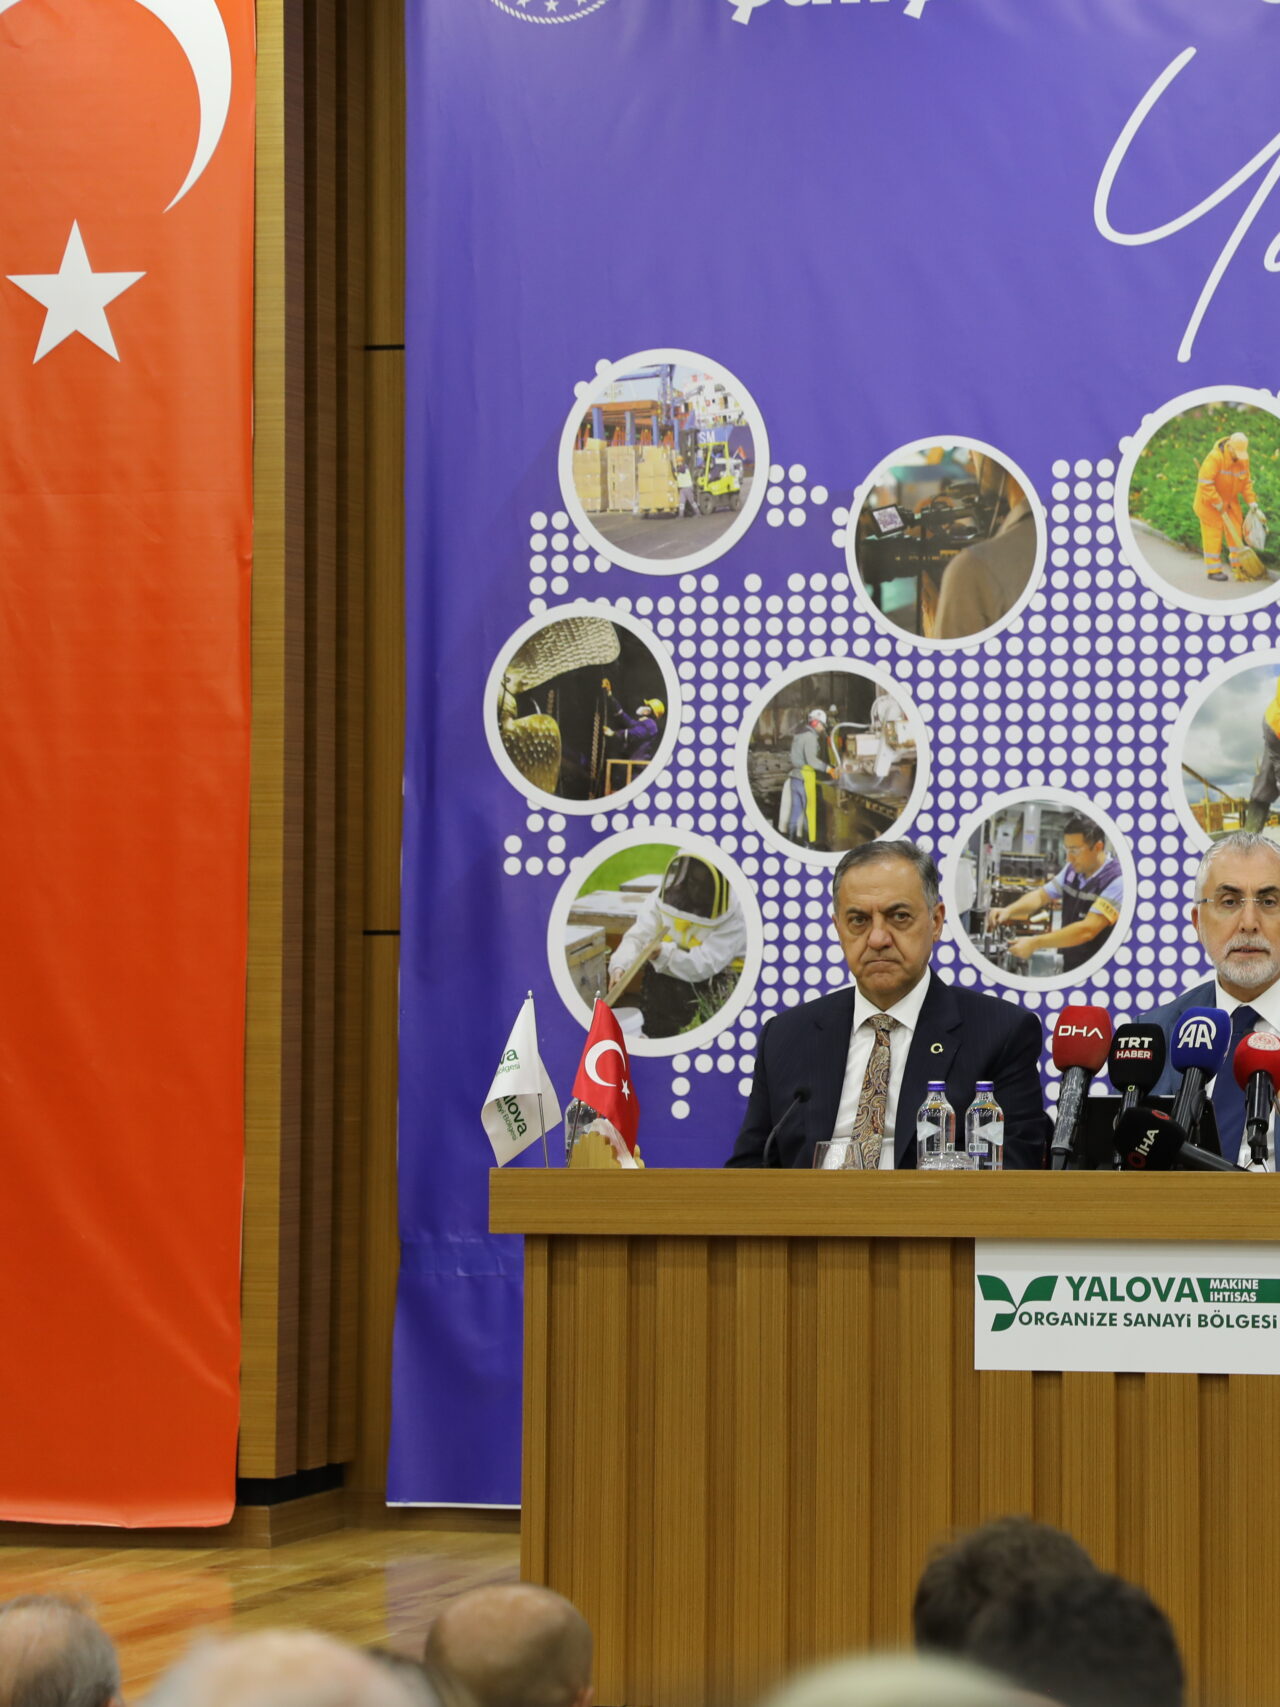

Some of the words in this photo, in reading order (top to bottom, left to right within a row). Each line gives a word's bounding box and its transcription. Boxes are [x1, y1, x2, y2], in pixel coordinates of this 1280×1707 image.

[1058, 1025, 1104, 1039] DHA
[1177, 1024, 1213, 1050] AA
[1118, 1037, 1153, 1049] TRT
[1116, 1050, 1151, 1059] HABER
[1065, 1276, 1199, 1303] YALOVA
